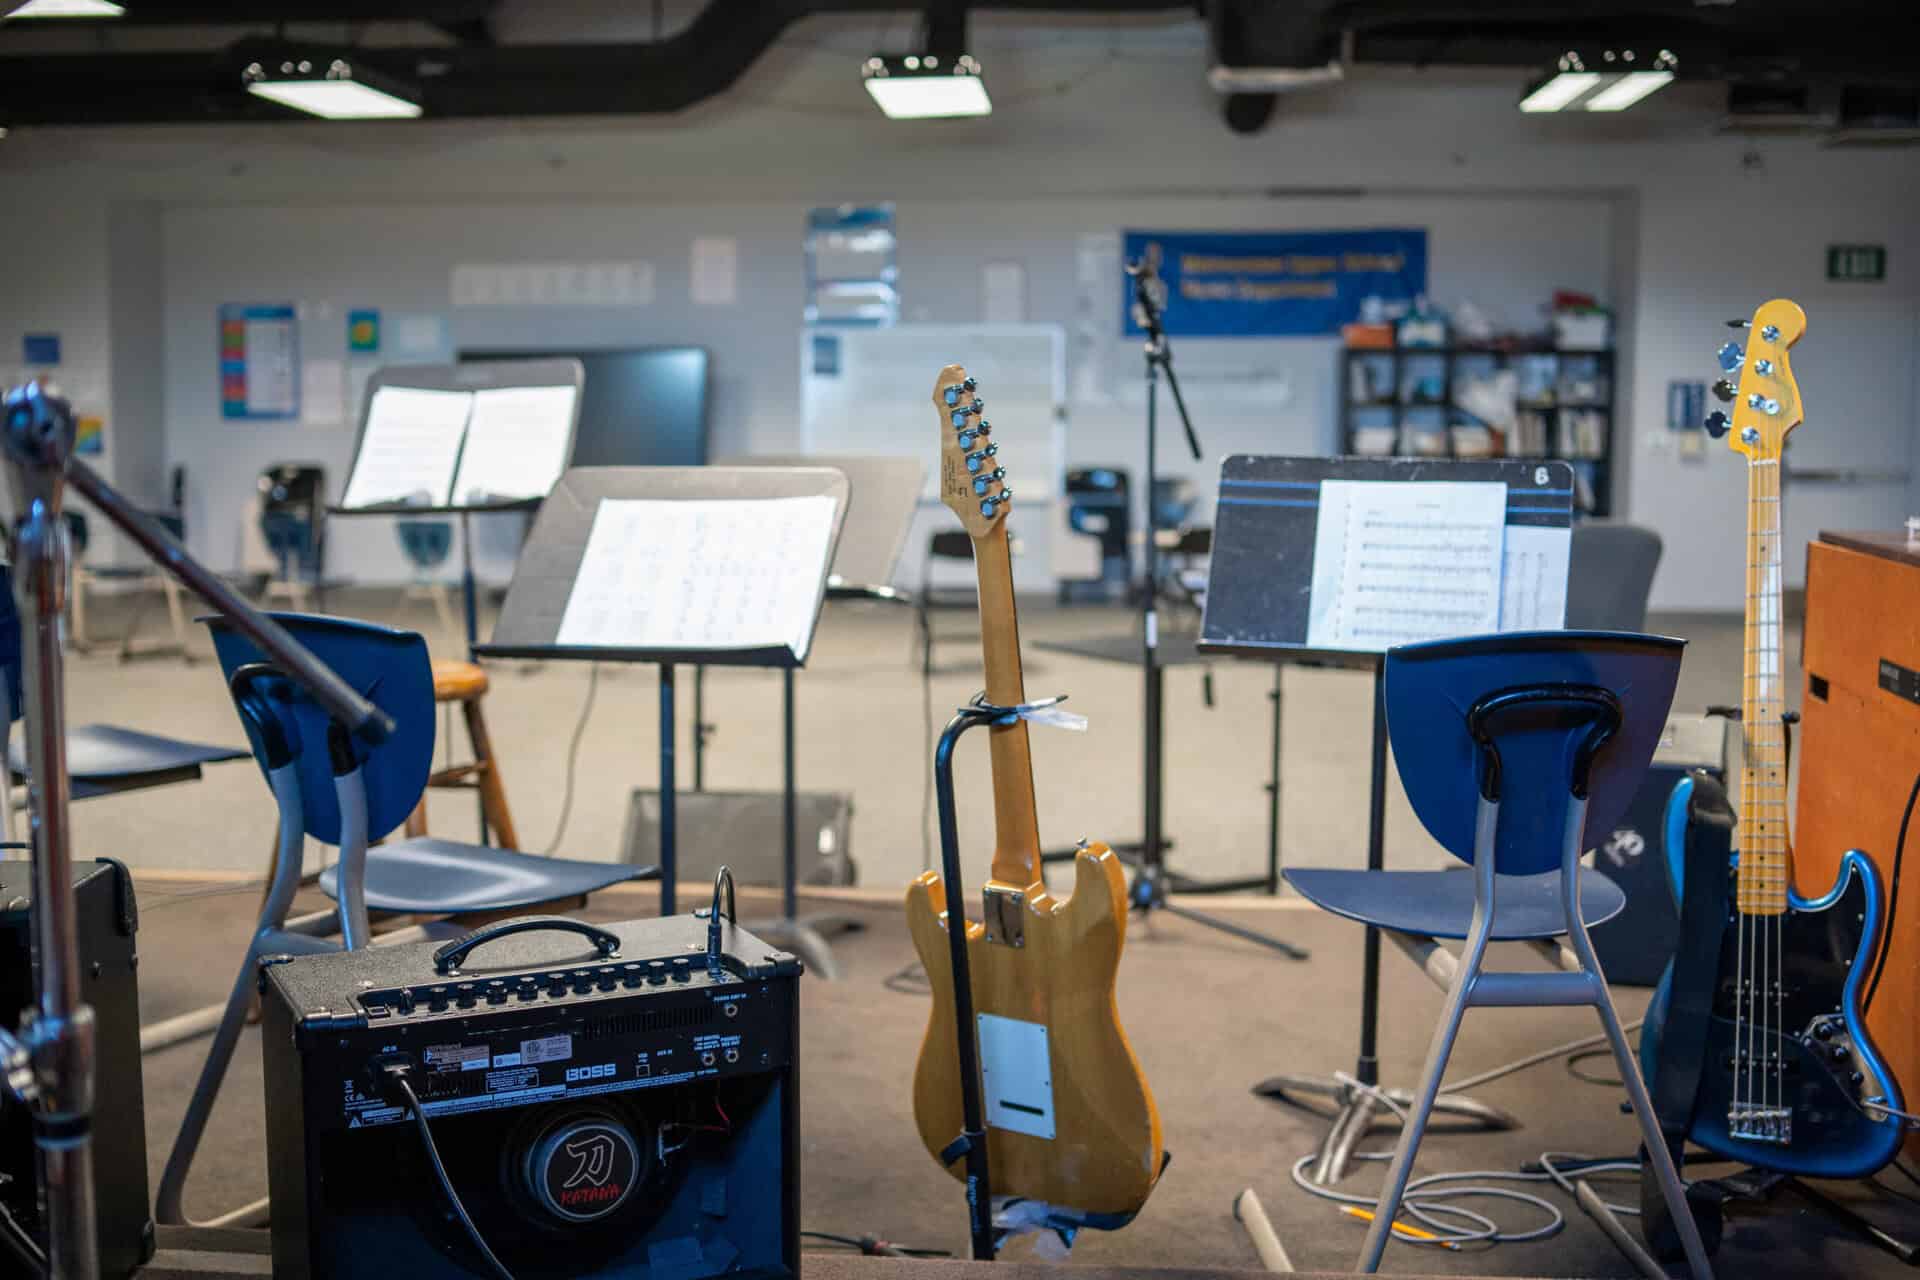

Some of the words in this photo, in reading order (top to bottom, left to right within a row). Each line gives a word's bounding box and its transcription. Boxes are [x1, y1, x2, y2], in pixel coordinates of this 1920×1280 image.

[1535, 466, 1549, 485] 6
[565, 1063, 617, 1082] BOSS
[563, 1134, 615, 1188] 刀
[561, 1183, 620, 1205] KATANA
